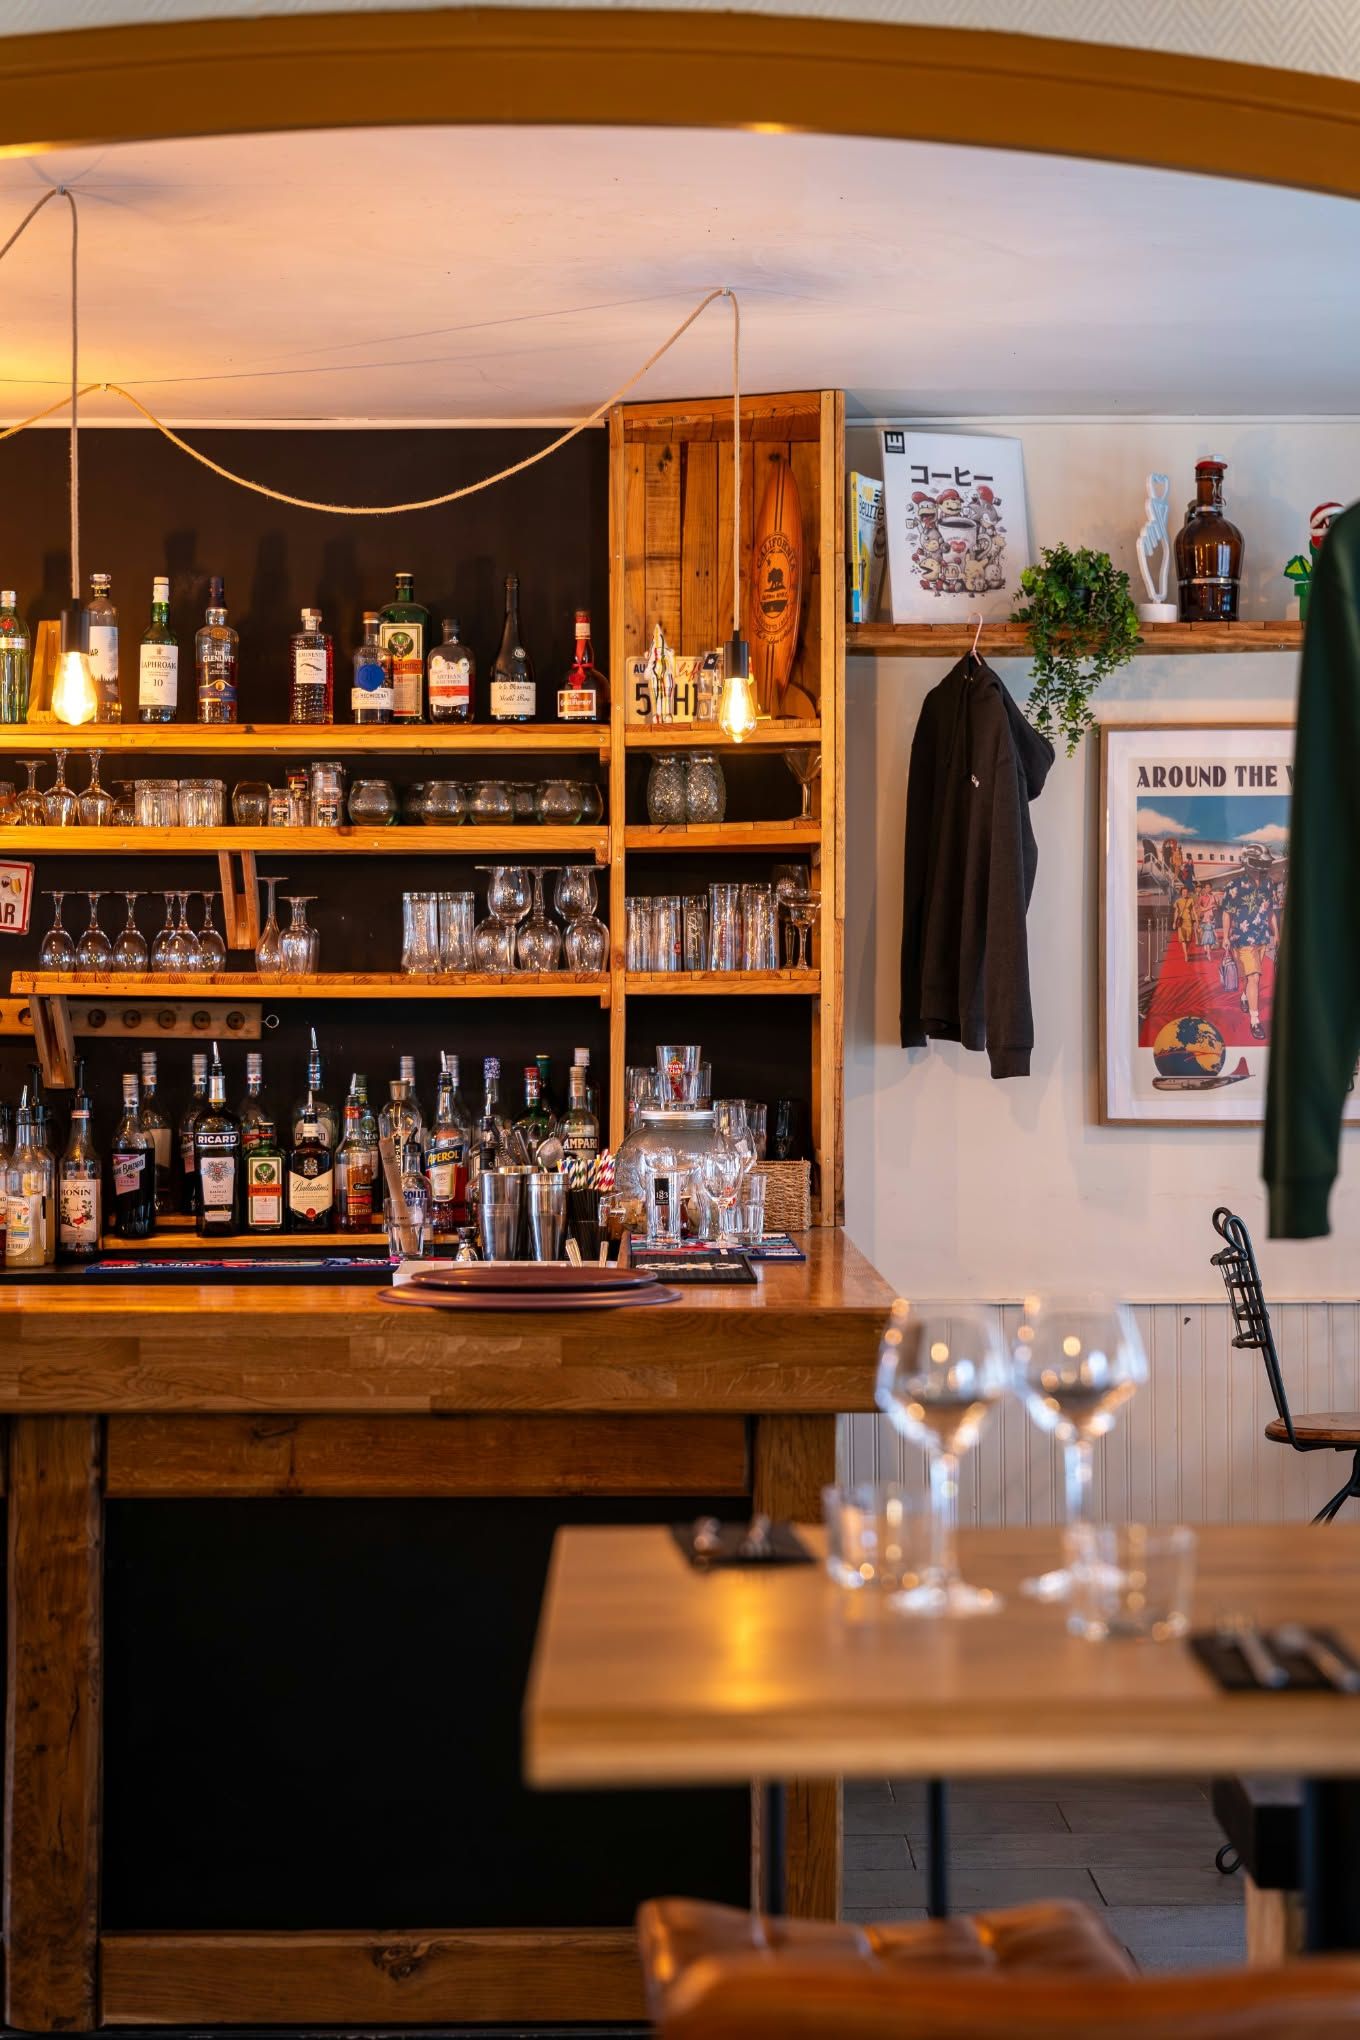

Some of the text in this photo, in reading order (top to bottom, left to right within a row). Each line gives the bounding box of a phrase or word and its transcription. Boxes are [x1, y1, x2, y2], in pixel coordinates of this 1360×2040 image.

[910, 464, 994, 487] コーヒー
[202, 655, 235, 663] GLENLIVET
[1136, 765, 1227, 788] AROUND
[1234, 765, 1278, 788] THE
[197, 1135, 237, 1144] RICARD
[562, 1138, 598, 1149] AMPARI
[427, 1149, 460, 1166] APEROL
[402, 1190, 428, 1199] SOLUT
